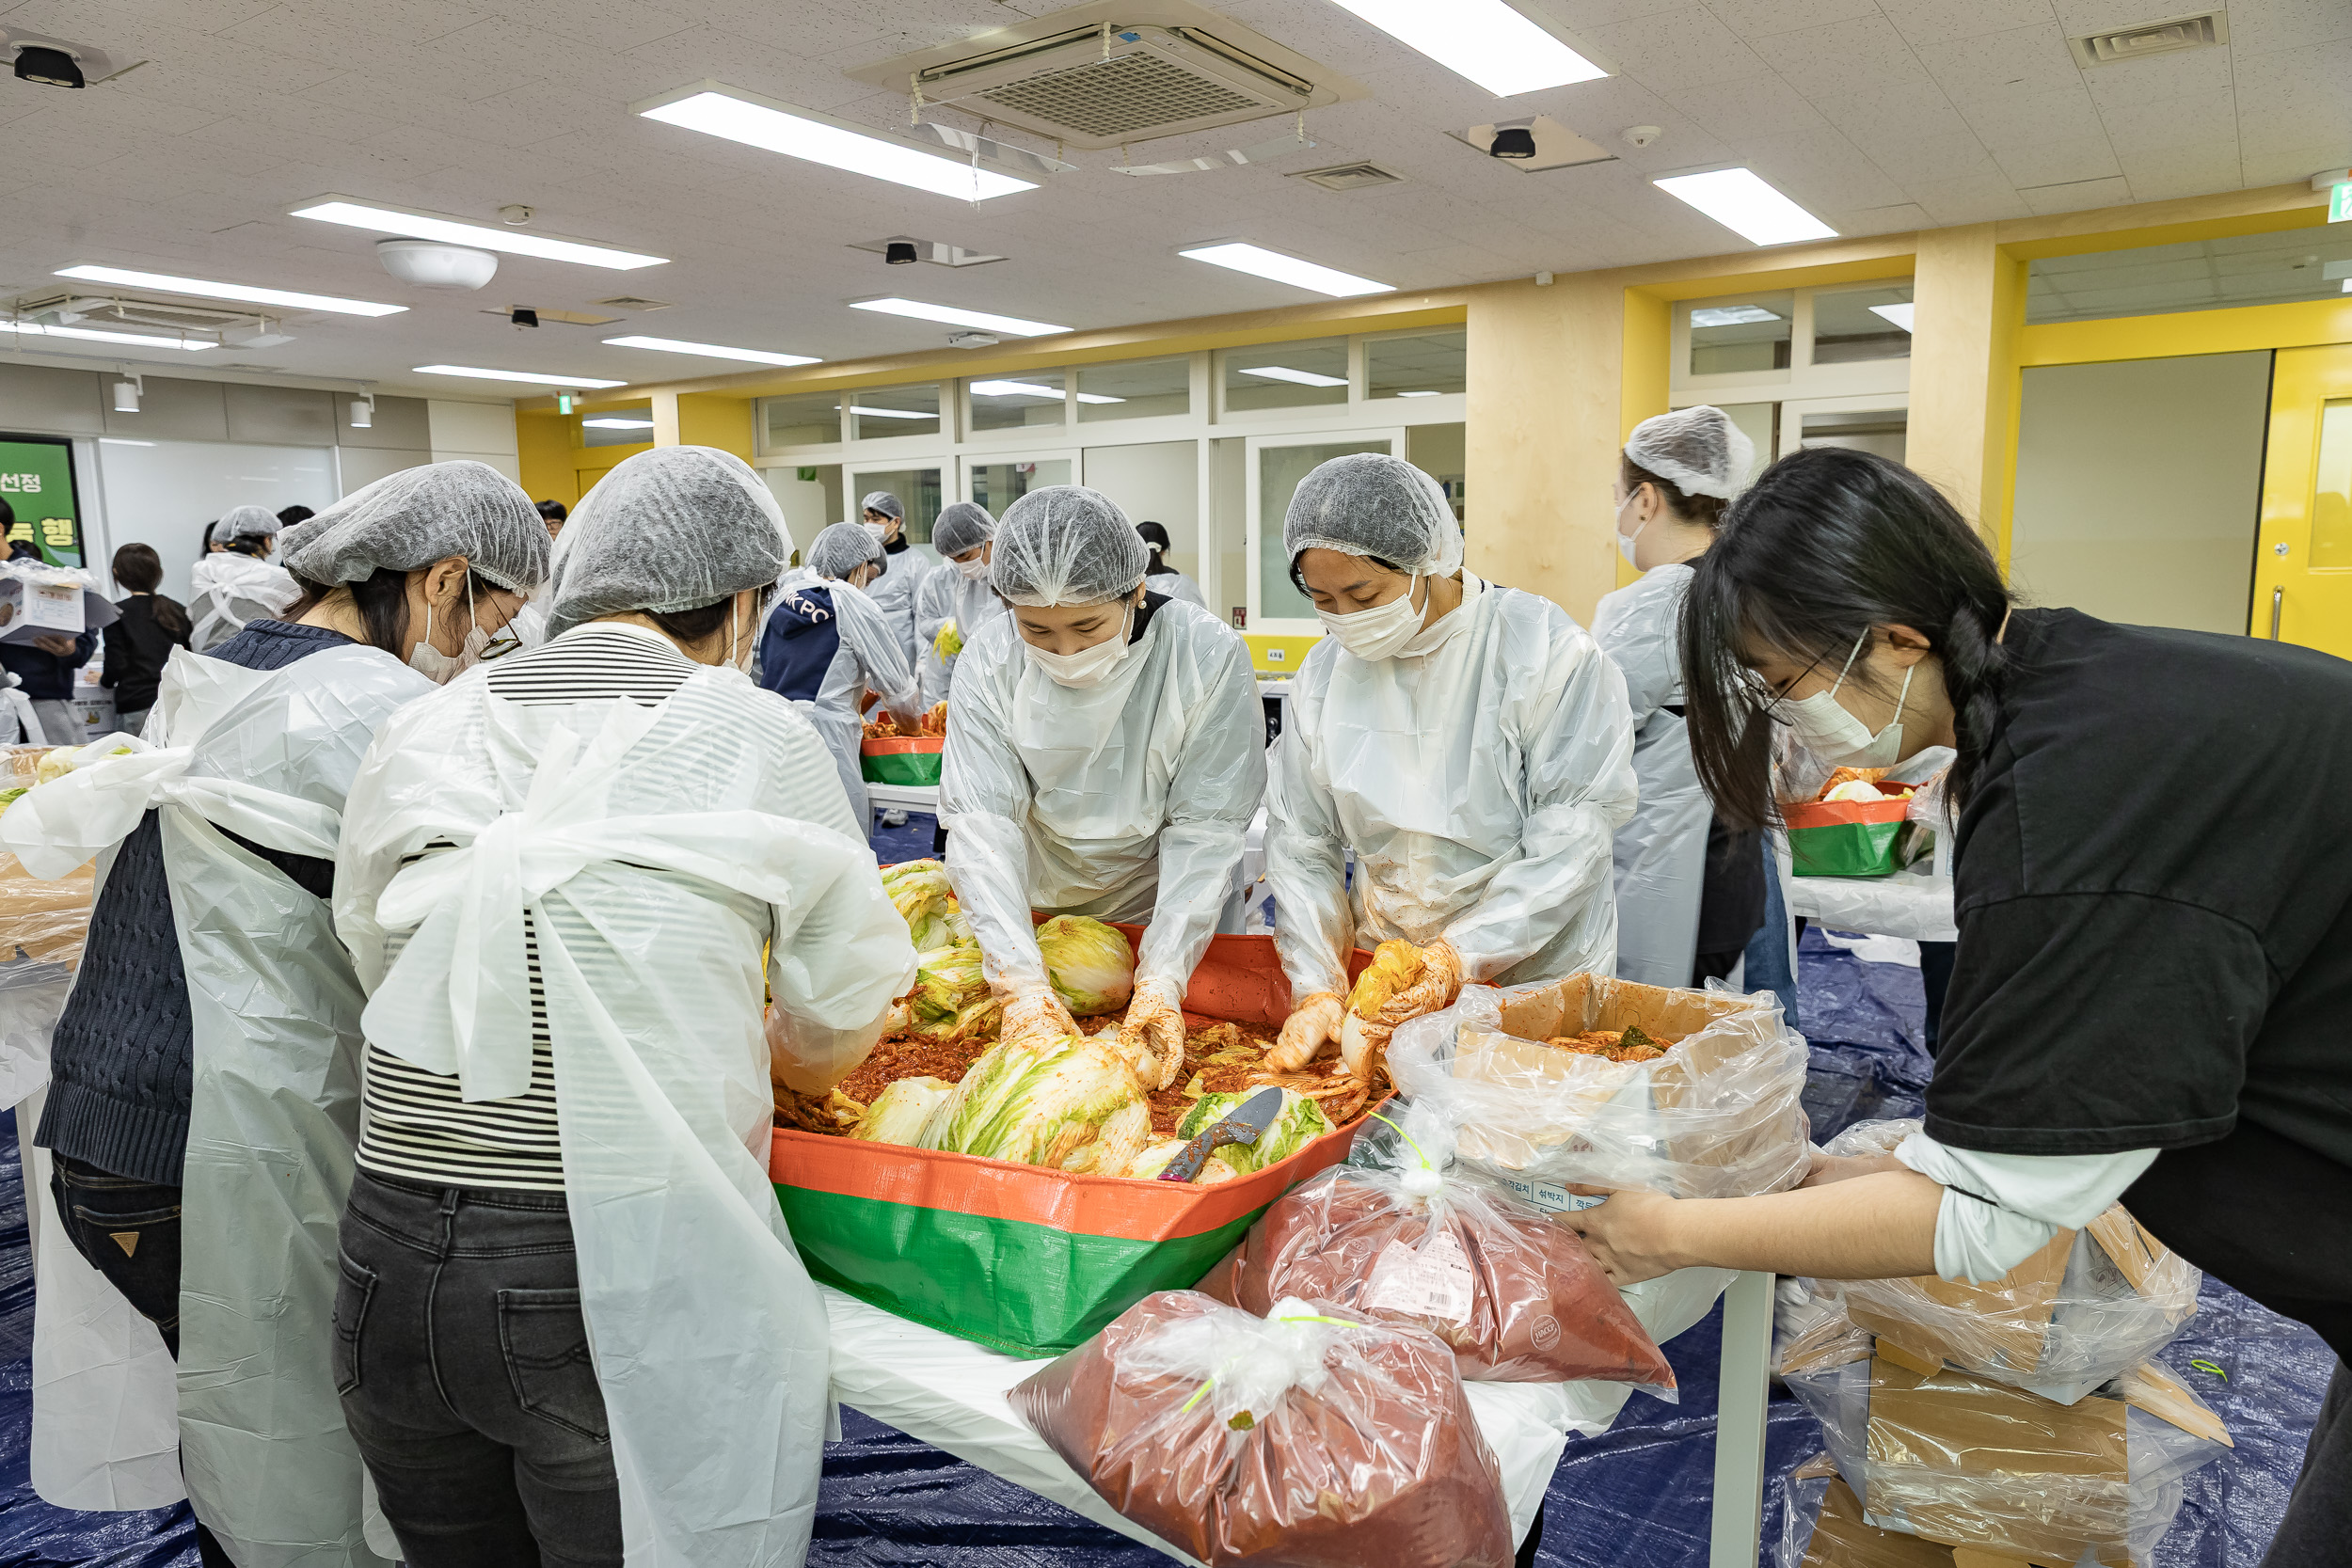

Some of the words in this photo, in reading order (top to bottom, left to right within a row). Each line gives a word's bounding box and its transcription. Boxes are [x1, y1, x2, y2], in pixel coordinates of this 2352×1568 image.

[0, 473, 41, 493] 선정
[1502, 1178, 1530, 1194] 각김치
[1538, 1189, 1564, 1204] 섞박지
